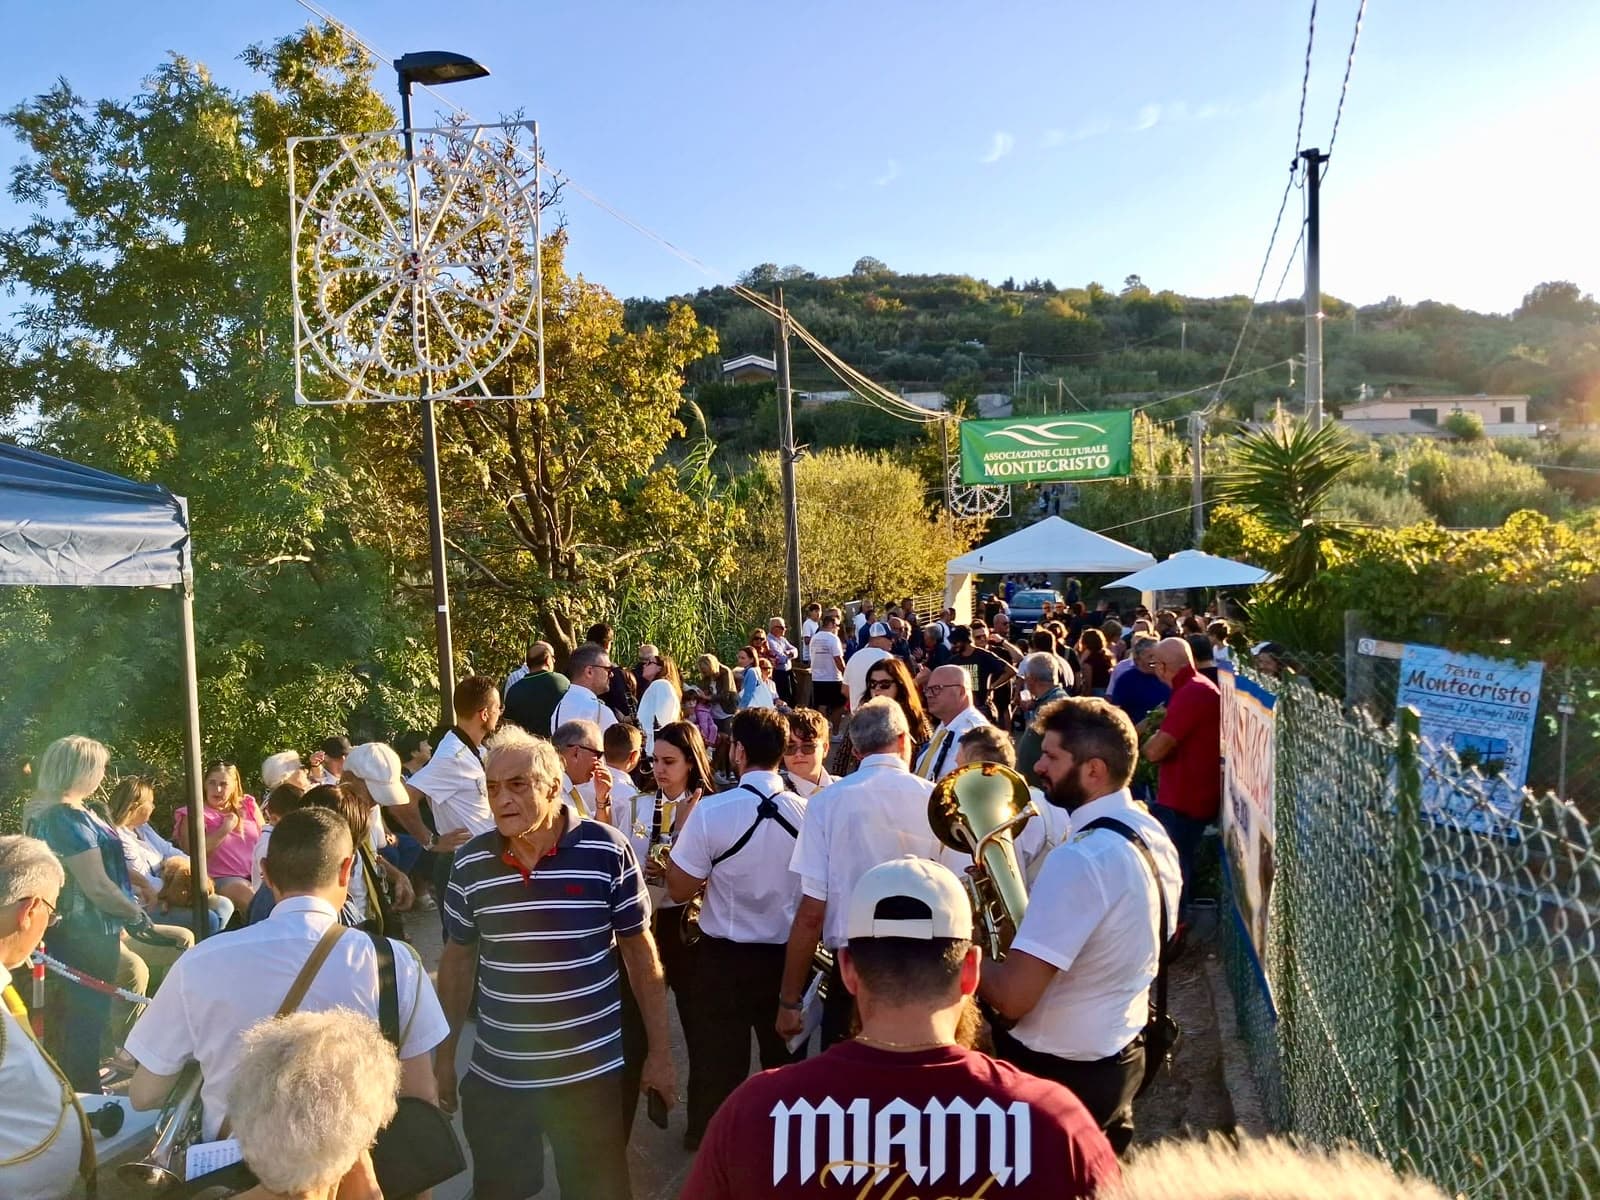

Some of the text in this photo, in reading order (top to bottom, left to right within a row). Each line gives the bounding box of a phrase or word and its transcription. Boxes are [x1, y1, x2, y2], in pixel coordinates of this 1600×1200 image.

[983, 444, 1108, 462] ASSOCIAZIONE CULTURALE
[983, 455, 1110, 477] MONTECRISTO
[1444, 663, 1495, 682] Festa a
[1404, 669, 1532, 705] Montecristo
[1506, 710, 1530, 723] 2026
[769, 1095, 1031, 1187] MIAMI
